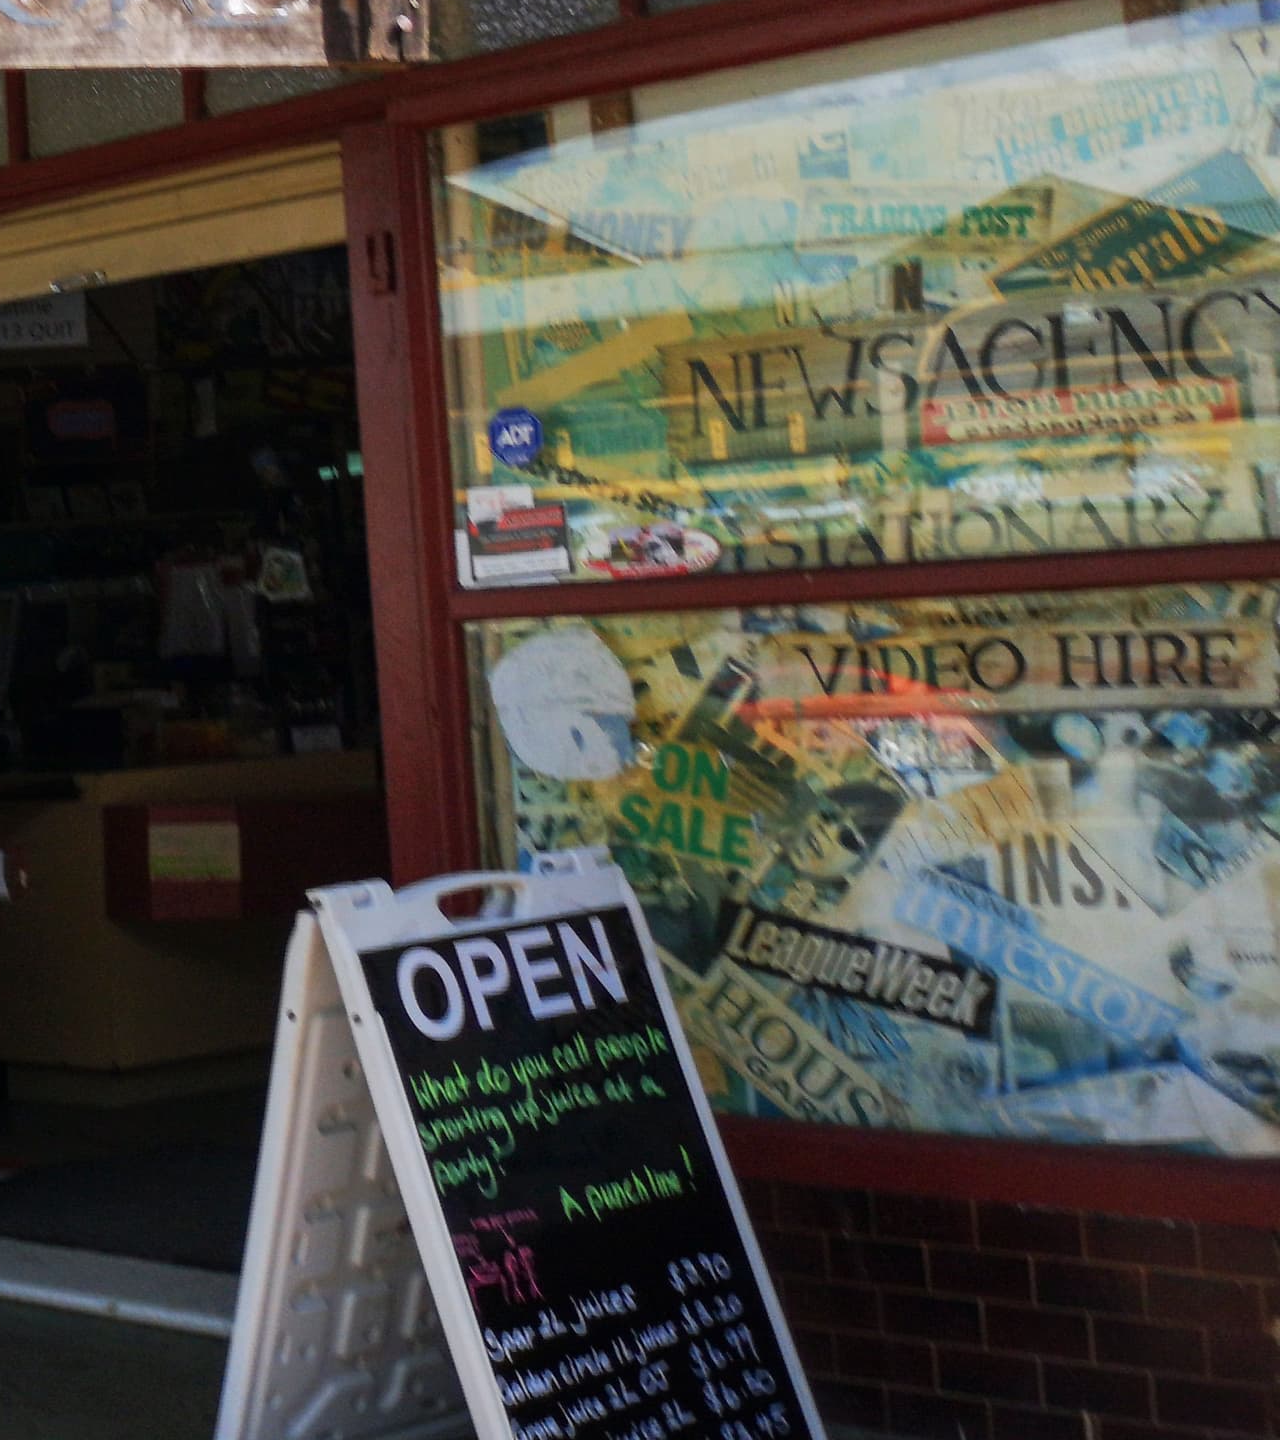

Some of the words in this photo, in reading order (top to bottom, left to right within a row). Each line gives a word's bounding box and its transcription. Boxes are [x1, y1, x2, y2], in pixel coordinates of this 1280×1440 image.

[960, 203, 1036, 238] POST
[791, 634, 1029, 696] VIDEO
[1053, 629, 1237, 691] HIRE
[652, 742, 731, 802] ON
[619, 793, 754, 867] SALE
[998, 830, 1132, 908] INS.
[397, 916, 629, 1040] OPEN
[408, 1059, 471, 1110] What
[476, 1056, 512, 1096] do
[510, 1053, 555, 1100] you
[551, 1031, 592, 1074] call
[594, 1023, 669, 1072] people
[603, 1073, 634, 1104] at
[639, 1074, 668, 1098] a
[559, 1184, 587, 1222] A
